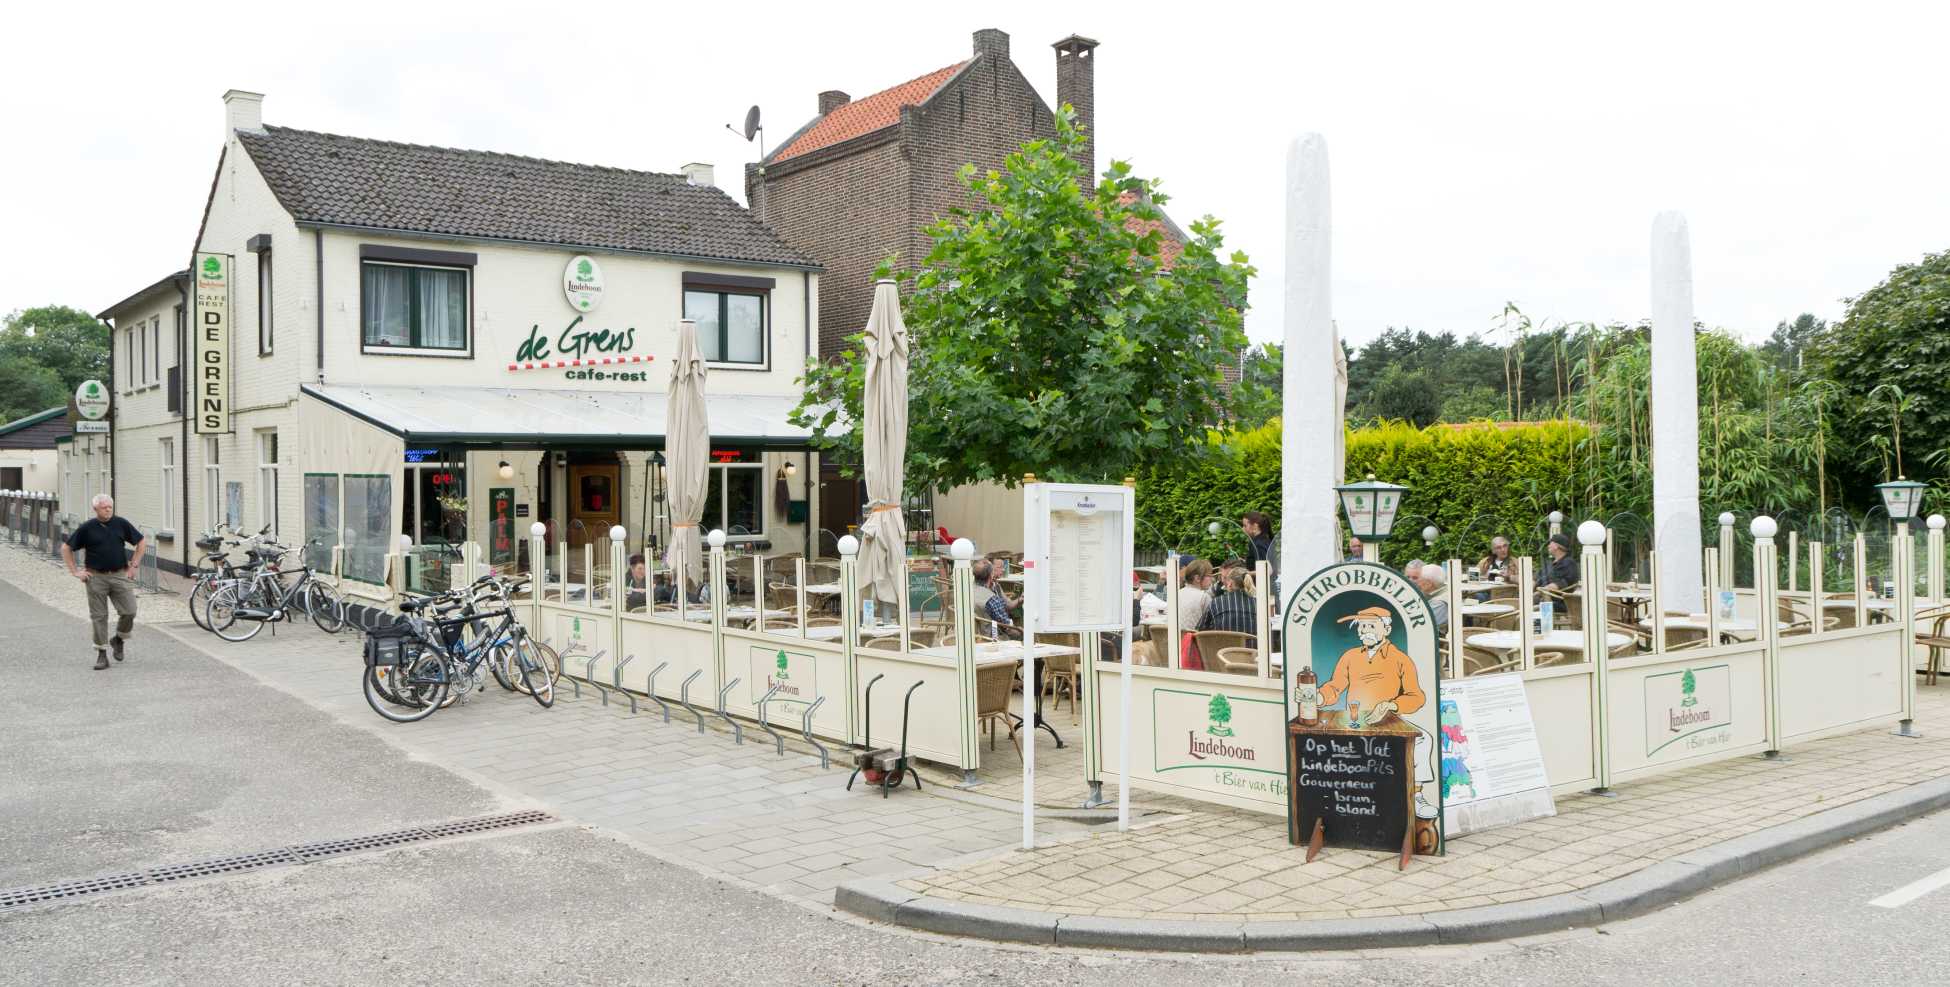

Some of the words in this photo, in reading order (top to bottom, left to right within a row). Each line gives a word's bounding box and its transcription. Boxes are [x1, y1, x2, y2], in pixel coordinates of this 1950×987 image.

[204, 311, 221, 341] DE
[516, 324, 551, 362] de
[557, 315, 636, 360] Grens
[565, 368, 648, 382] cafe-rest
[203, 350, 222, 429] GRENS
[1669, 708, 1711, 733] Lindeboom
[1188, 730, 1256, 760] Lindeboom
[1305, 737, 1328, 756] Op
[1330, 739, 1358, 755] het
[1360, 736, 1392, 758] Vat
[1223, 772, 1247, 787] Bier
[1249, 779, 1267, 792] van
